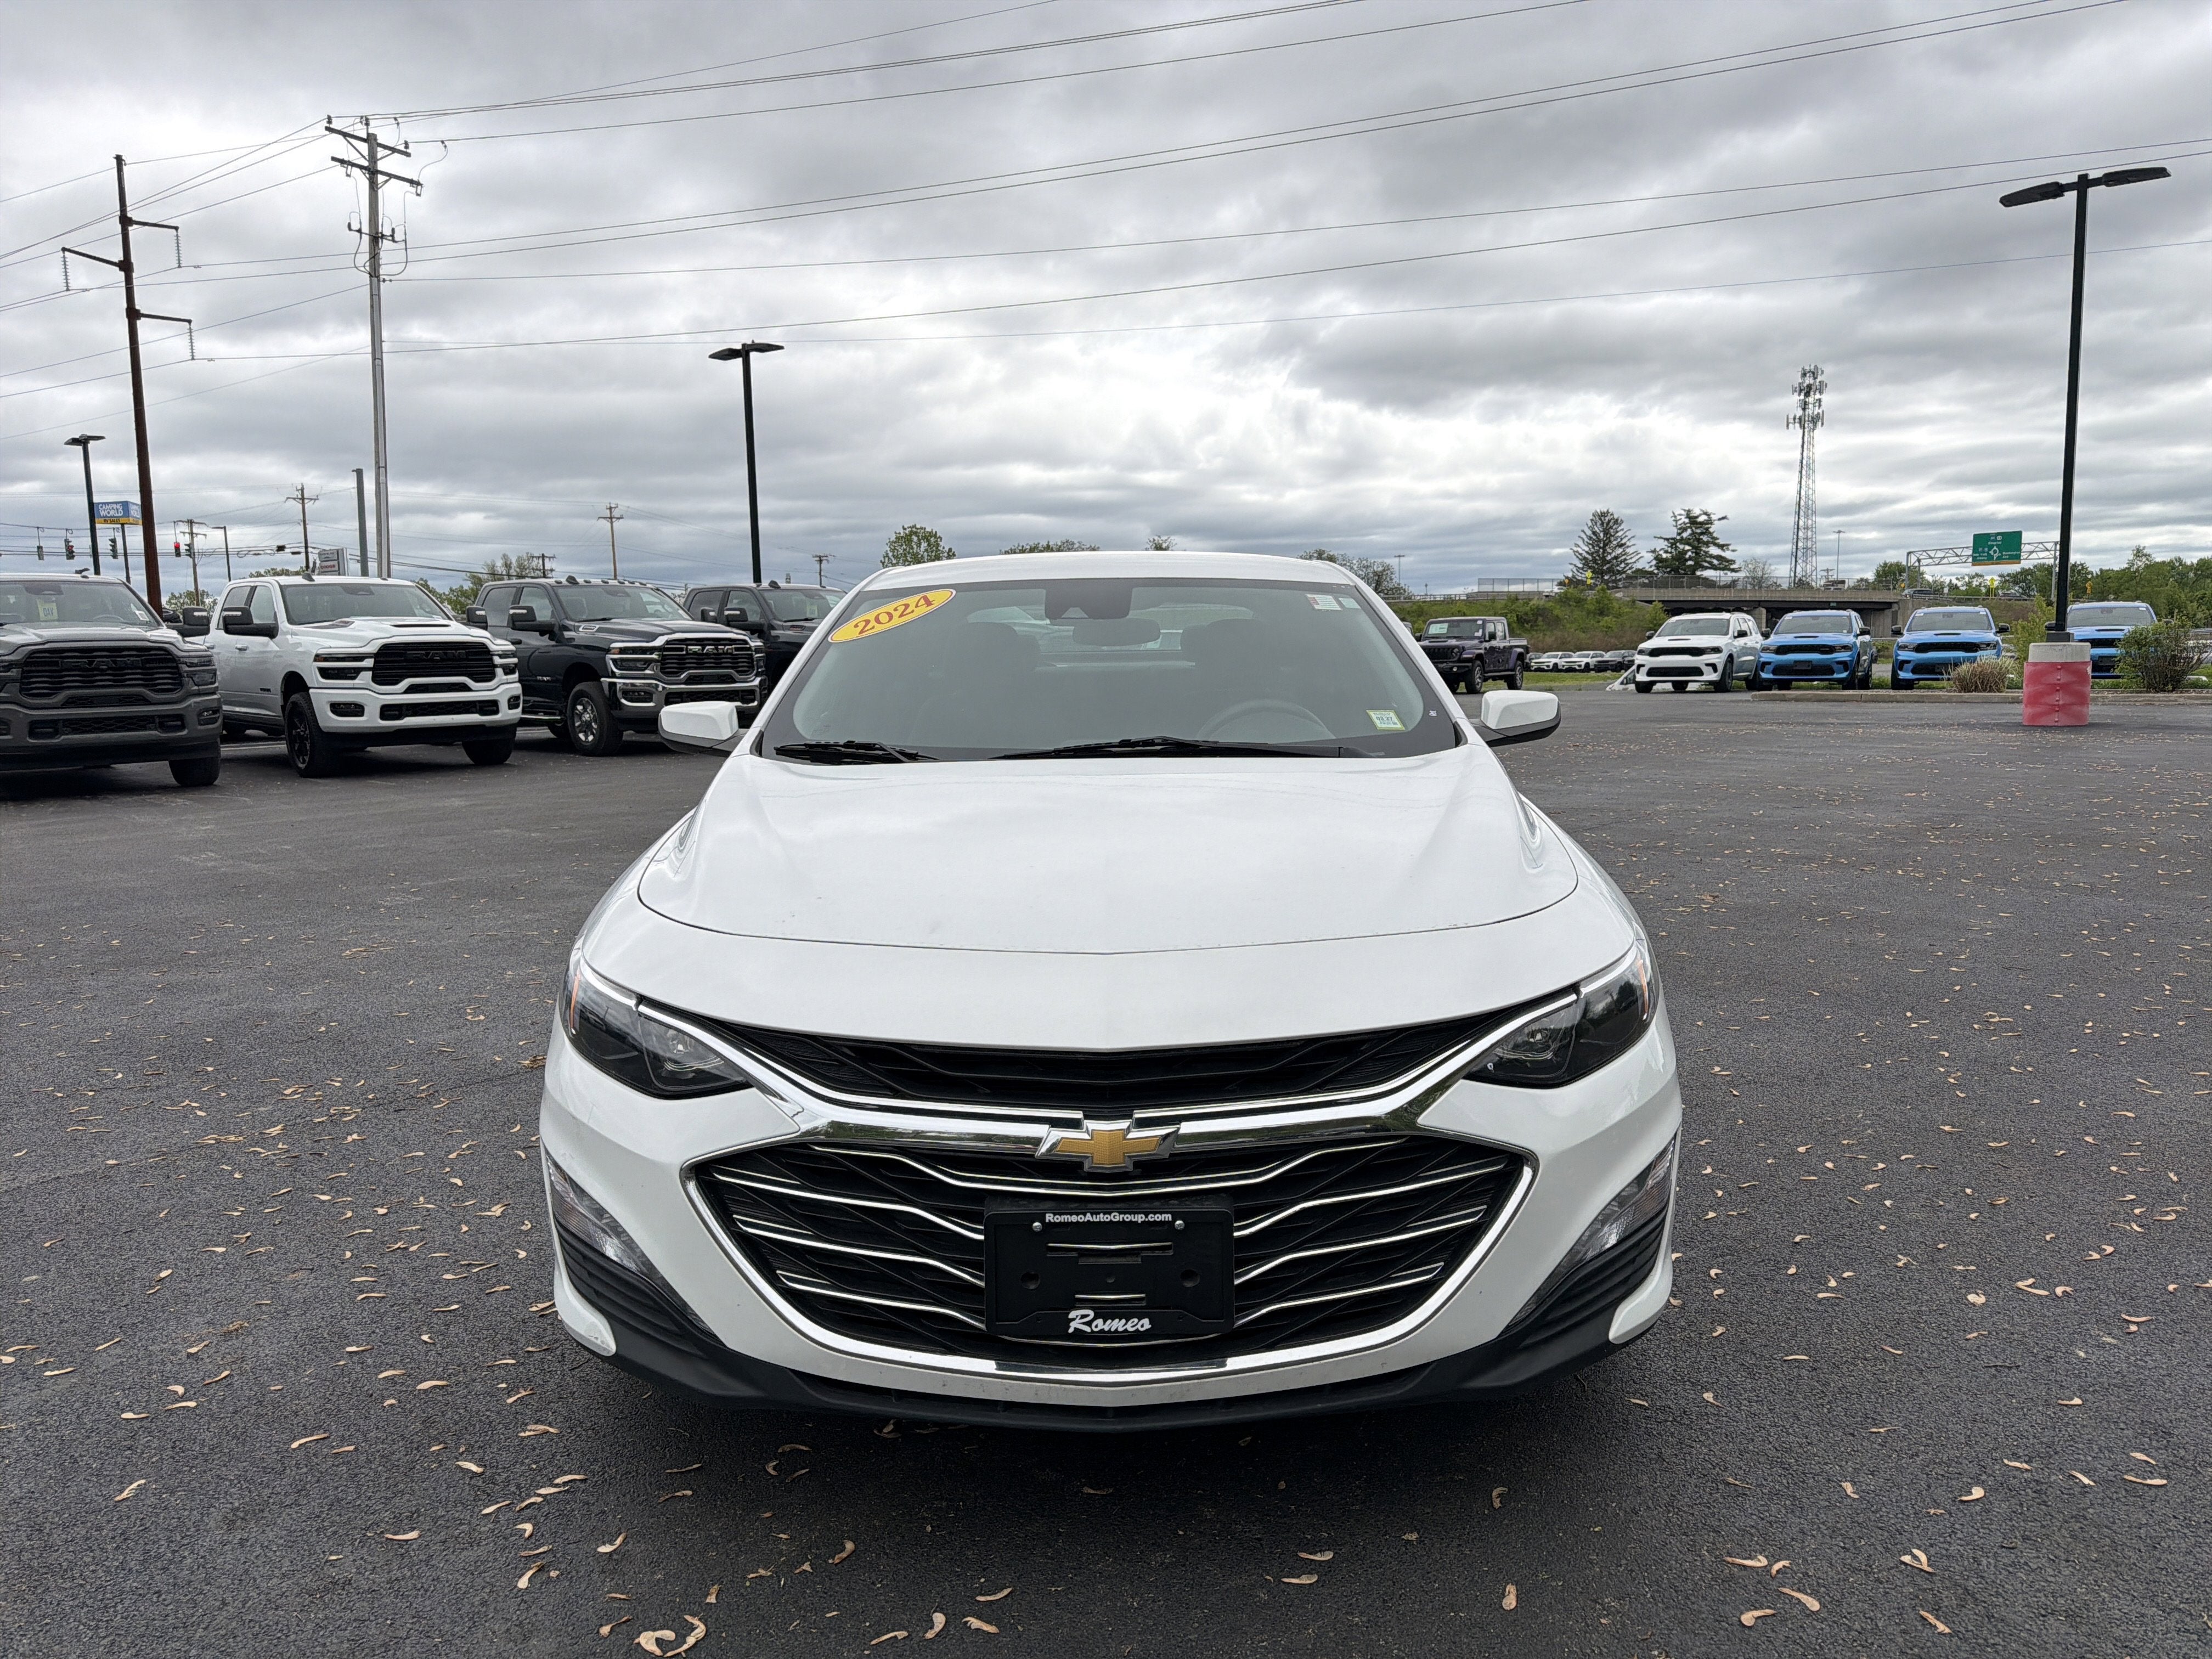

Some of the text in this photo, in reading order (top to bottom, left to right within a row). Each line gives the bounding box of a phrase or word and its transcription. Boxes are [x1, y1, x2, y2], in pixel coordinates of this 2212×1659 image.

[853, 595, 935, 635] 2024
[406, 651, 466, 659] RAM
[60, 659, 144, 669] RAM
[1046, 1212, 1172, 1223] RomeoAutoGroup.com
[1068, 1309, 1152, 1334] Romeo
